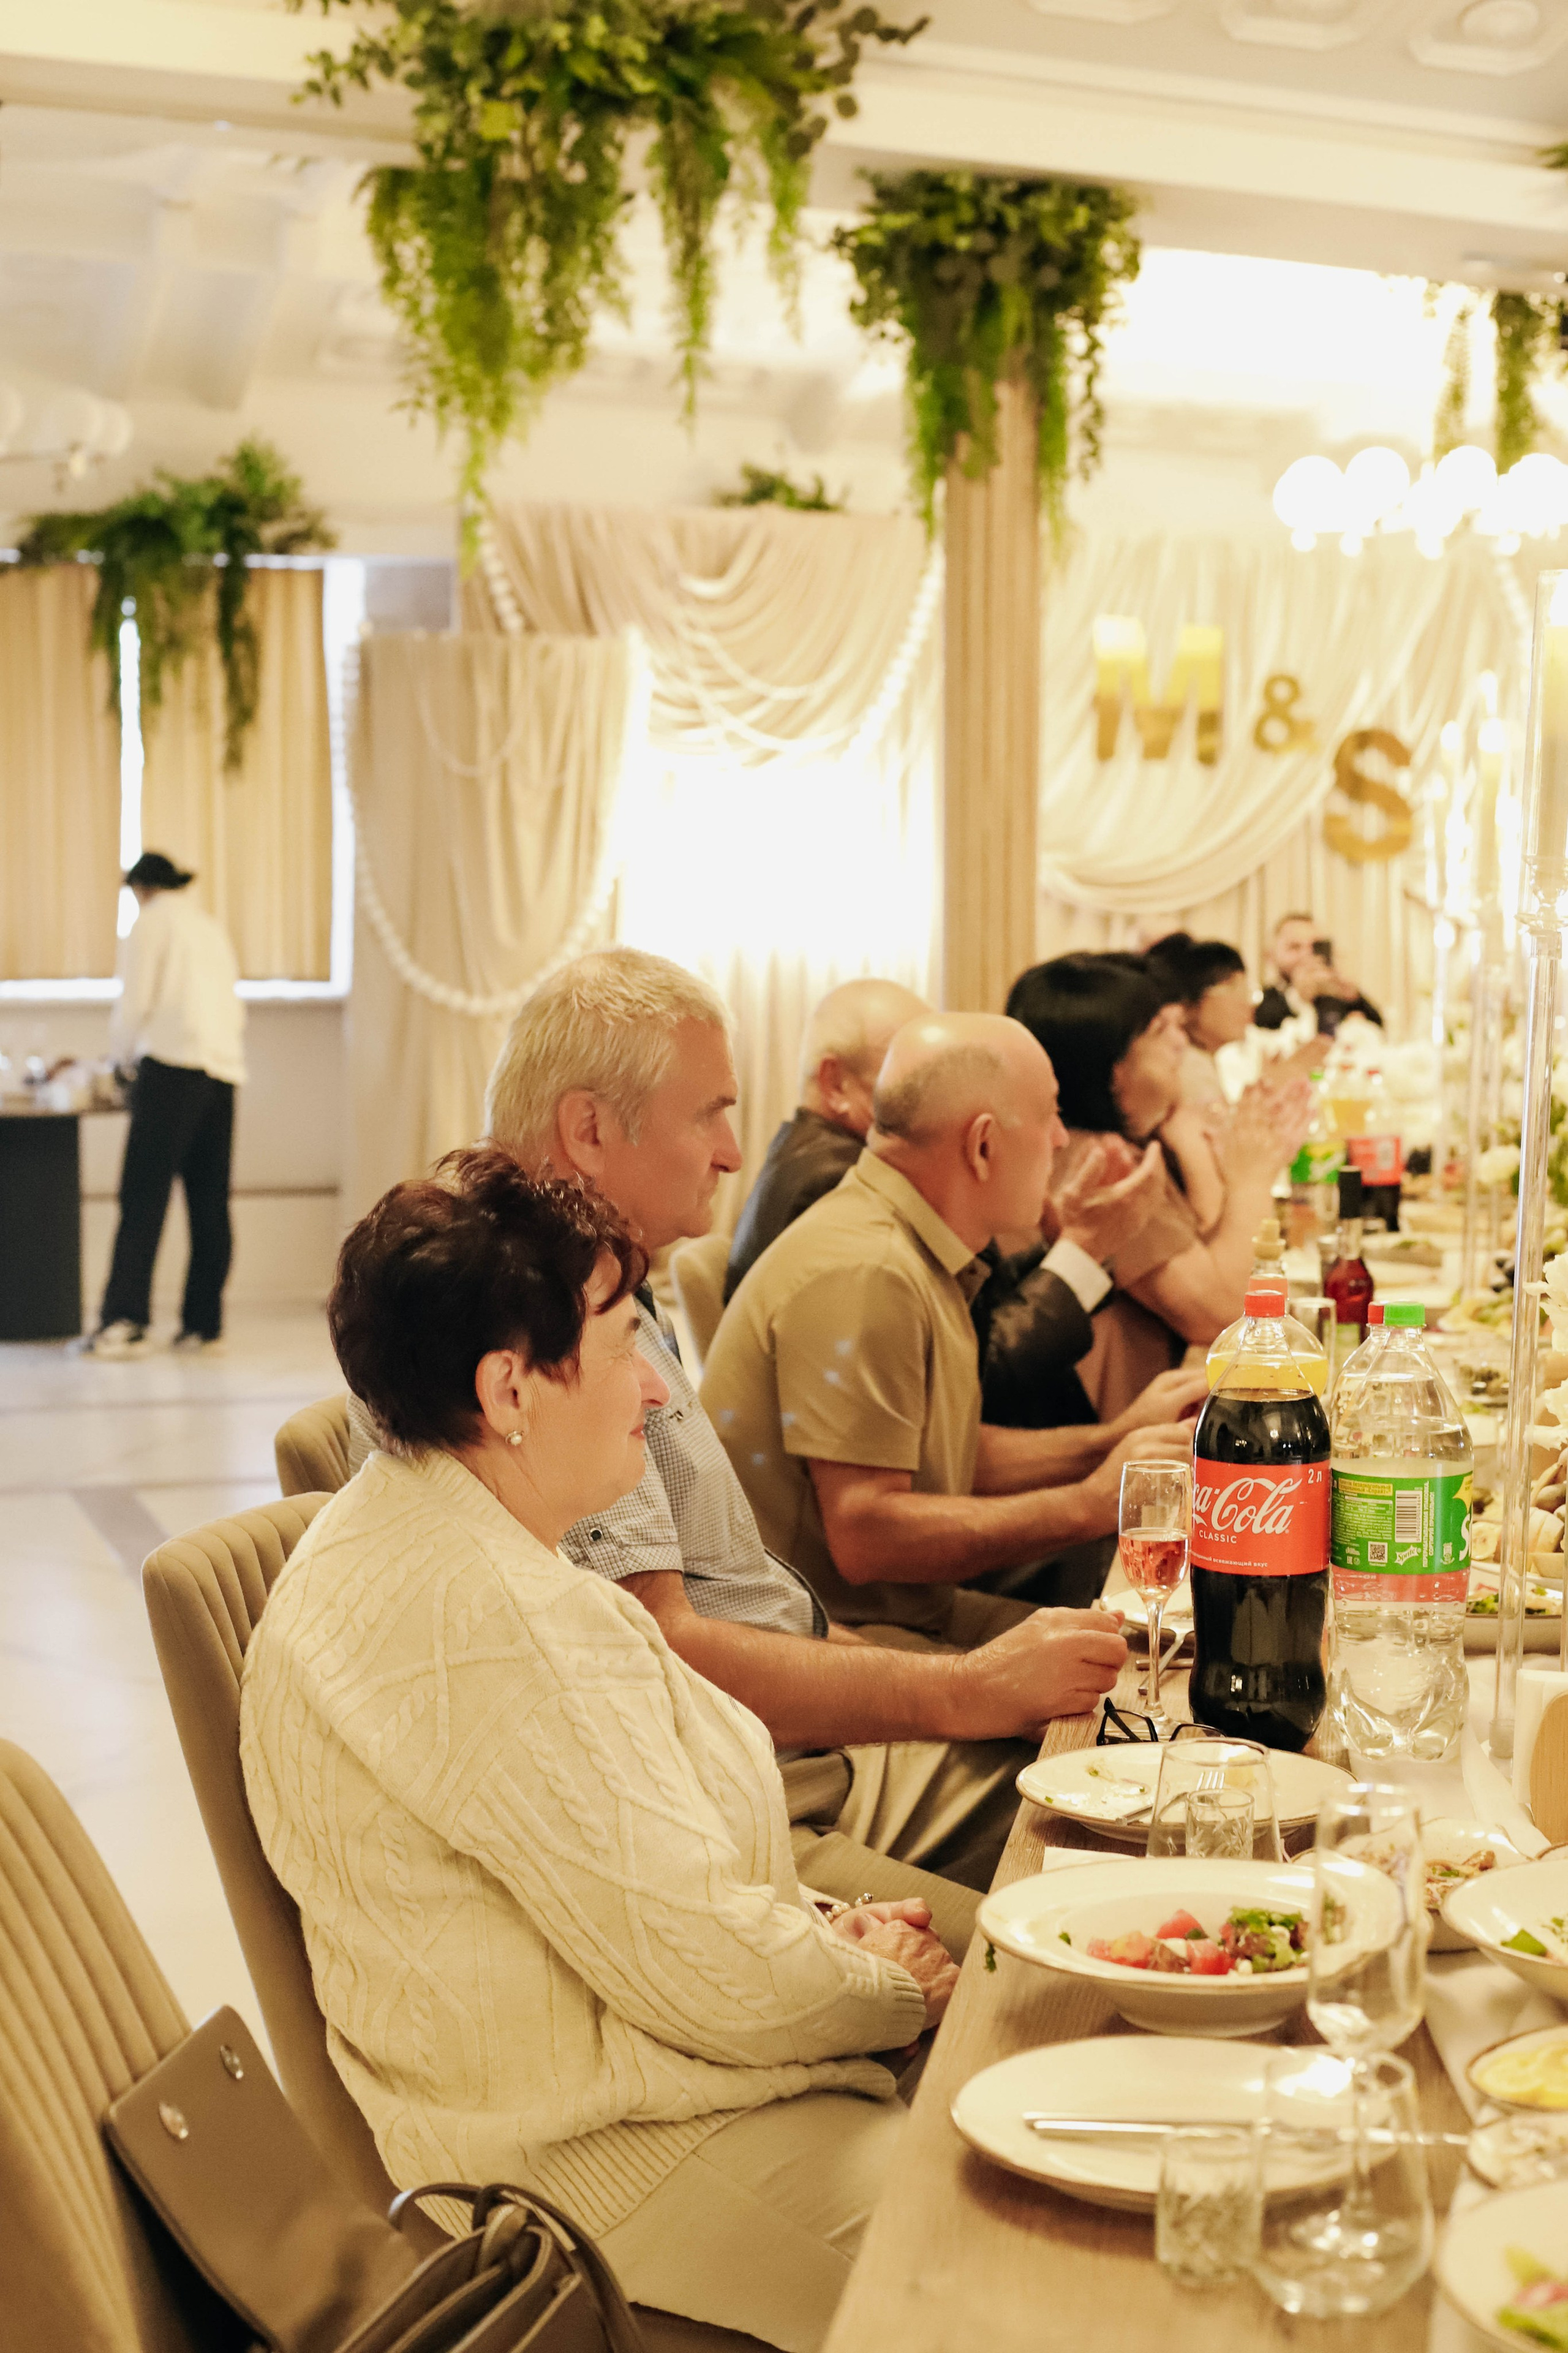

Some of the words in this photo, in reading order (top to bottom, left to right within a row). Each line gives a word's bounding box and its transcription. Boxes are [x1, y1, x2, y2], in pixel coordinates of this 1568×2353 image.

[1093, 615, 1223, 766] M
[1254, 674, 1317, 753] &
[1323, 729, 1412, 861] S
[1308, 1468, 1314, 1484] 2
[1193, 1477, 1303, 1535] ca-Cola
[1199, 1530, 1237, 1544] CLASSIC
[1398, 1549, 1415, 1562] Sprite
